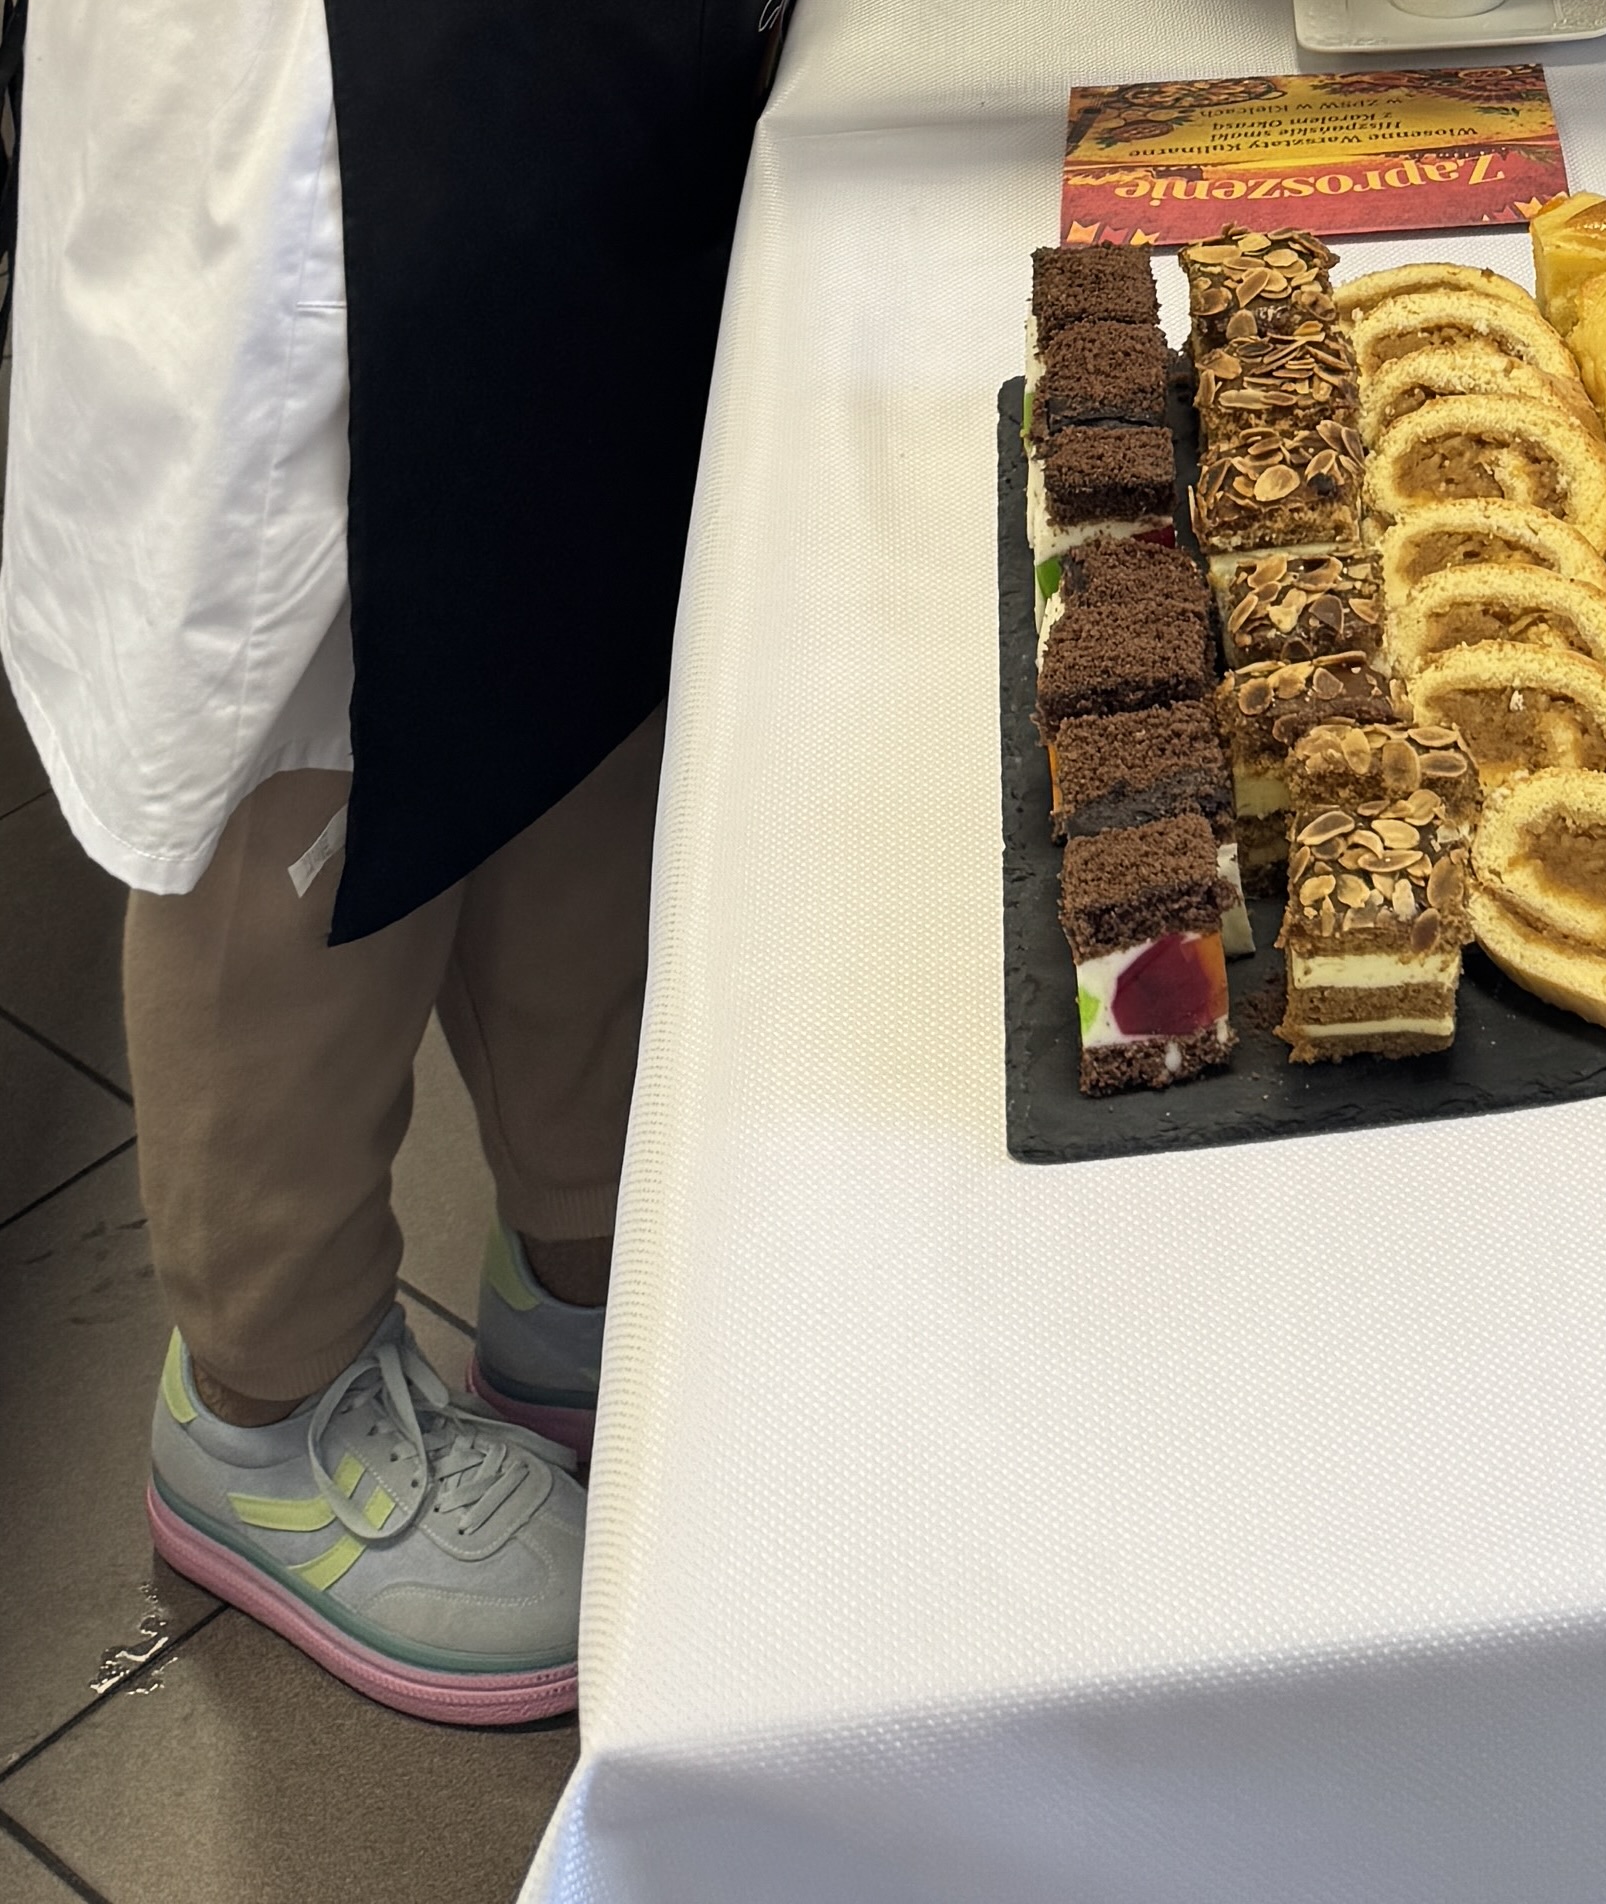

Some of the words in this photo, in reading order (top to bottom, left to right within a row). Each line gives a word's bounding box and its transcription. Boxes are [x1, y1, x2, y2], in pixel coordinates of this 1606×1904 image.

[1200, 103, 1288, 118] Kielcach
[1289, 112, 1375, 129] Karolem
[1210, 128, 1272, 142] smaki
[1278, 120, 1401, 138] Hiszpańskie
[1368, 126, 1478, 141] Wiosenne
[1249, 134, 1361, 150] Warsztaty
[1129, 143, 1241, 157] Kulinarne
[1114, 154, 1505, 206] Zaproszenie
